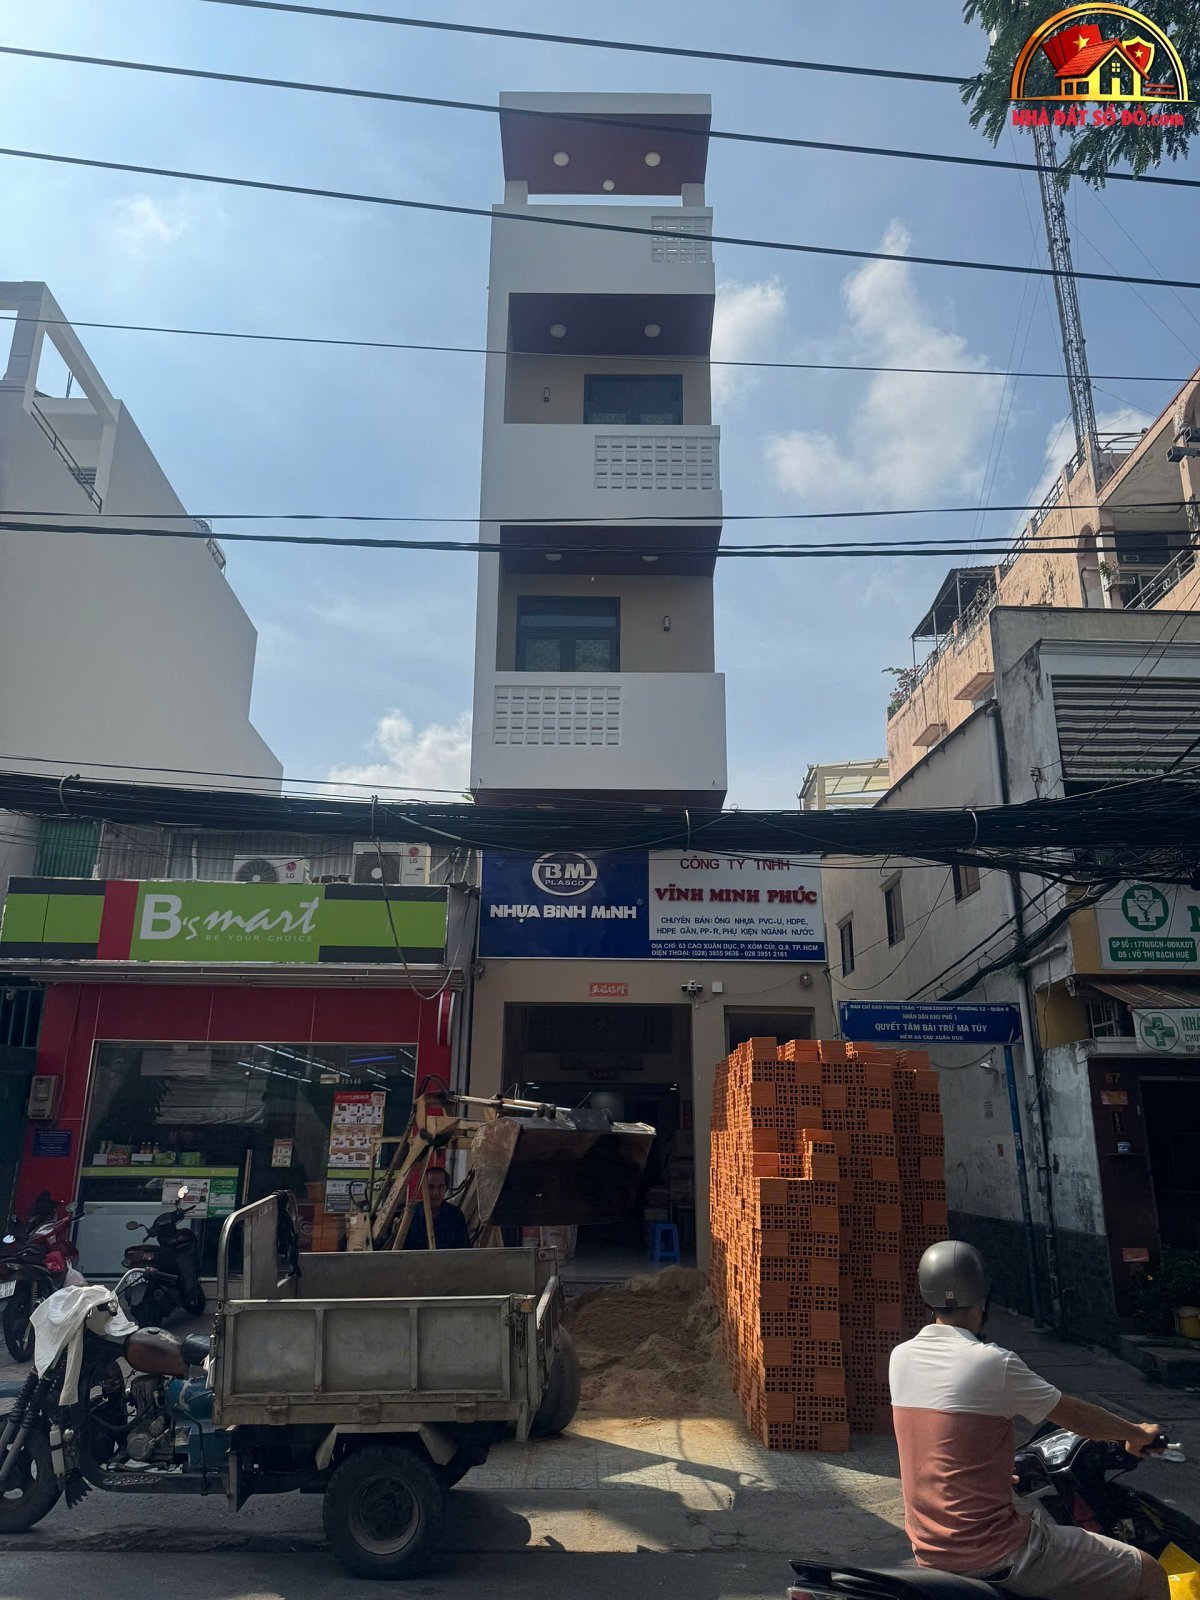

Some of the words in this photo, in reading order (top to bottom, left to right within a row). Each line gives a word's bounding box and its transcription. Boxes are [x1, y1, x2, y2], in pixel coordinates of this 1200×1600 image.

[680, 855, 720, 870] CÔNG
[728, 859, 746, 870] TY
[754, 859, 790, 871] TNHH
[545, 862, 588, 880] BM
[655, 883, 704, 902] VĨNH
[709, 889, 760, 903] MINH
[766, 886, 817, 904] PHÚC
[490, 904, 541, 923] NHỰA
[661, 916, 691, 924] CHUYÊN
[267, 935, 313, 943] CHOICE
[875, 1020, 901, 1032] QUYẾT
[903, 1021, 920, 1031] TÂM
[922, 1022, 936, 1032] BÀI
[956, 1025, 970, 1033] MA
[1105, 1072, 1121, 1084] 67
